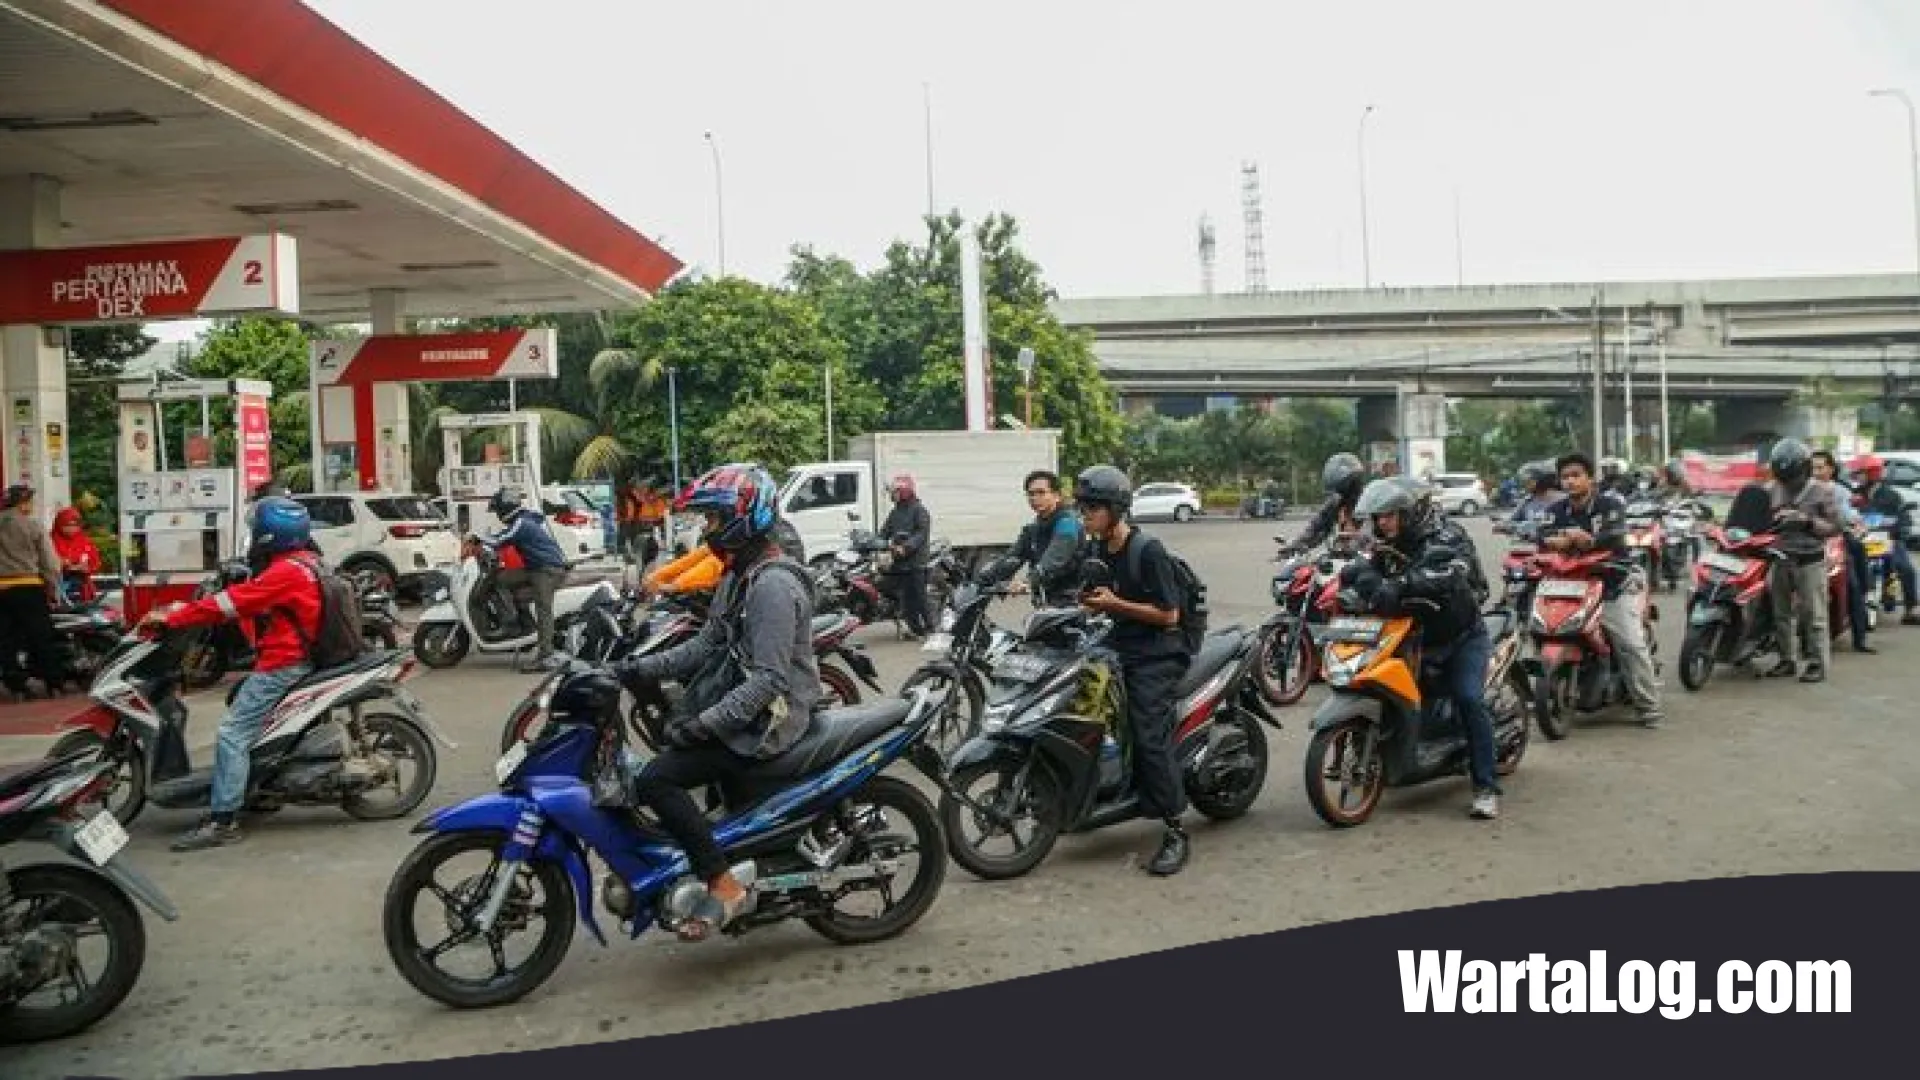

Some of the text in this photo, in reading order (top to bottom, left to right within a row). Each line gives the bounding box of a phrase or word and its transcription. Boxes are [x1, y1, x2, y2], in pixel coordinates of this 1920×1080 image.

[243, 260, 263, 285] 2
[52, 273, 188, 301] PERTAMINA
[98, 297, 145, 318] DEX
[528, 345, 541, 360] 3
